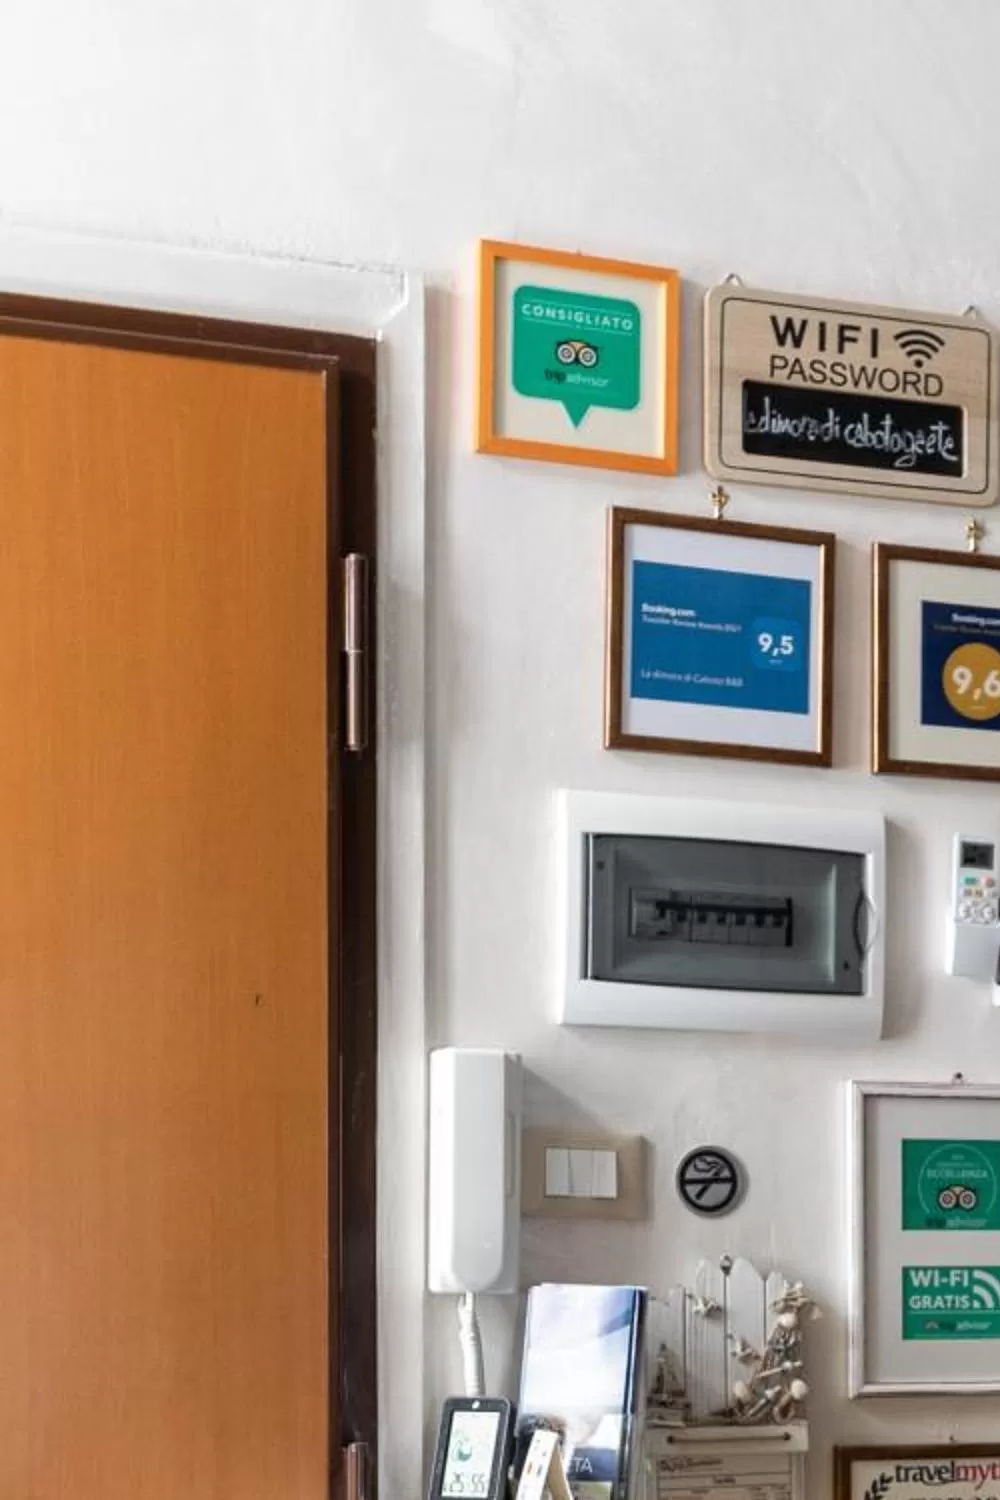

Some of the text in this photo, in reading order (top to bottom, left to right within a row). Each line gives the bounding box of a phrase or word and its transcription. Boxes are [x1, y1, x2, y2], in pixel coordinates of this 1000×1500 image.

[521, 302, 634, 331] CONSIGLIATO
[770, 315, 879, 359] WIFI
[769, 354, 944, 398] PASSWORD
[758, 632, 794, 657] 9,5
[909, 1268, 969, 1288] WI-FI
[908, 1295, 970, 1310] GRATIS
